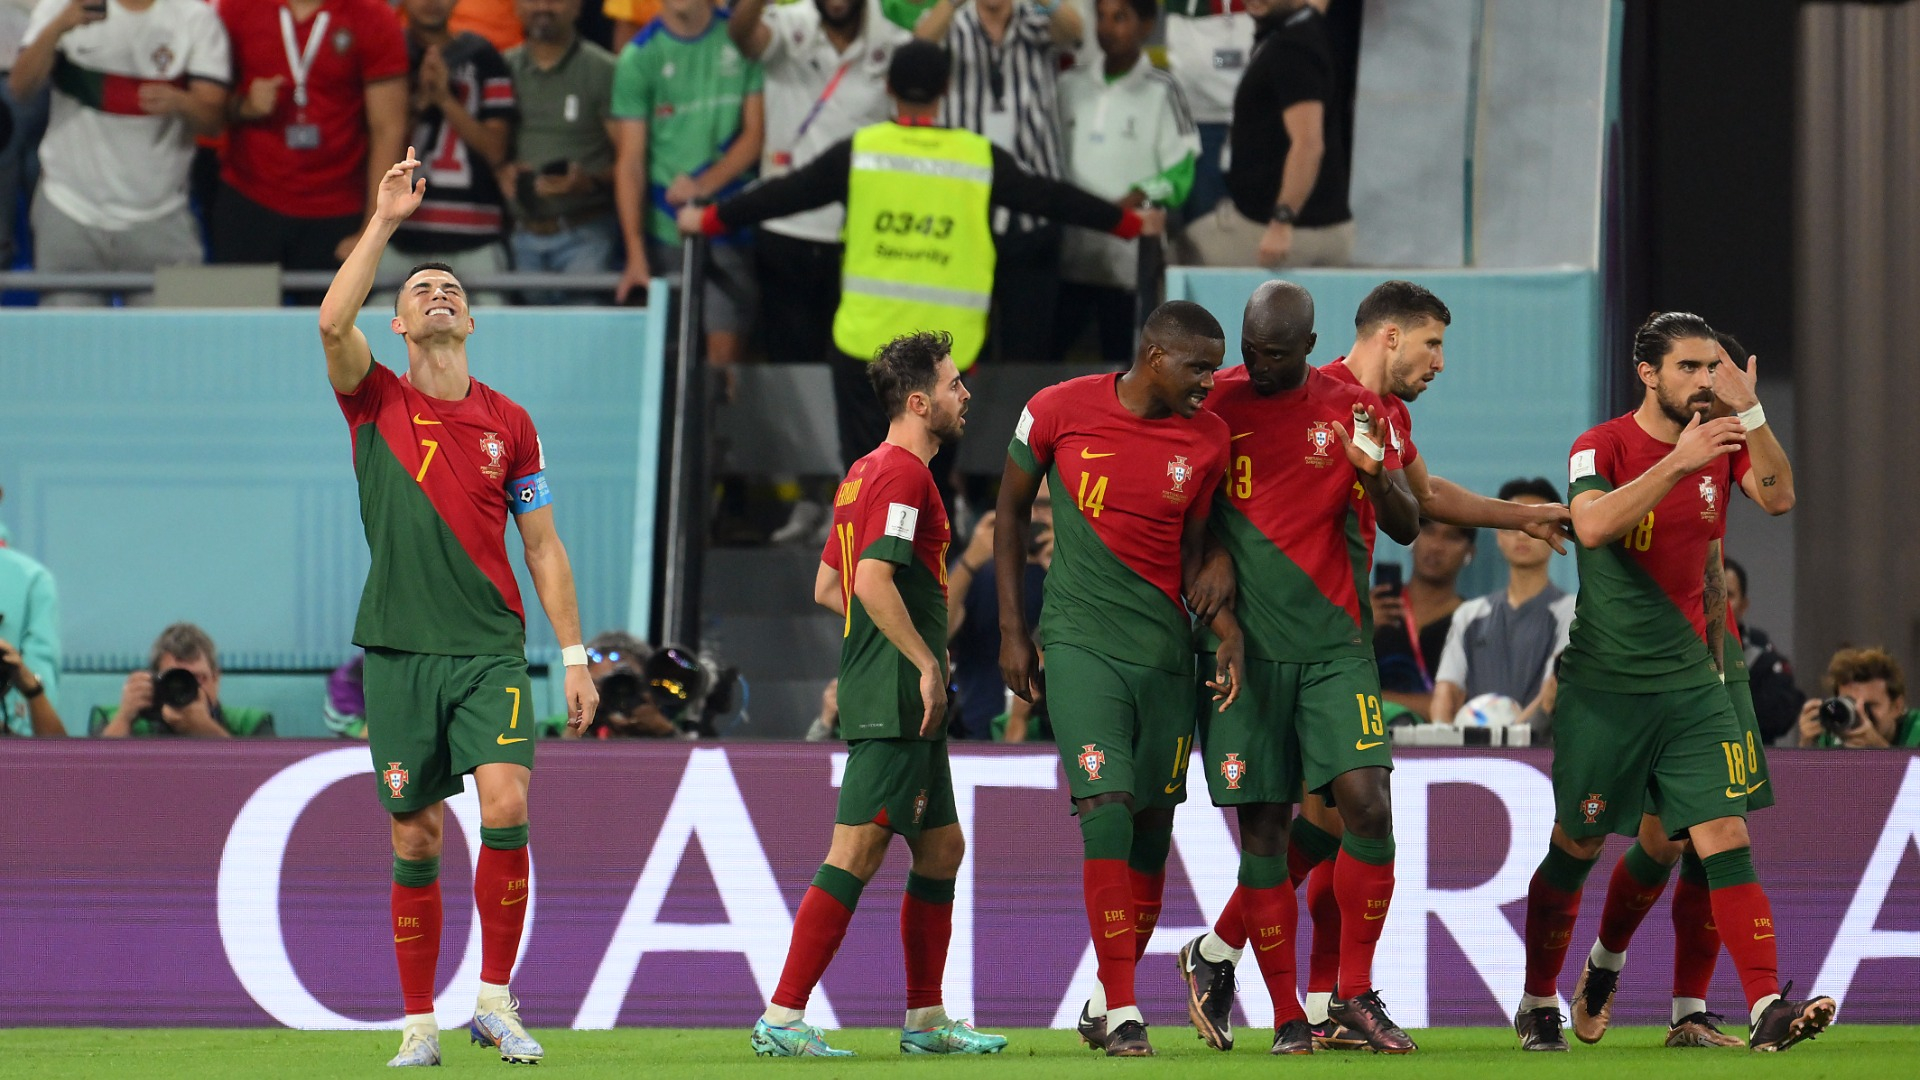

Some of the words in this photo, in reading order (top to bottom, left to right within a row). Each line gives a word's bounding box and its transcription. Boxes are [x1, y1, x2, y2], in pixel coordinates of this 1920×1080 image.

[874, 210, 955, 239] 0343
[875, 243, 951, 267] Security
[417, 440, 438, 482] 7
[1078, 472, 1109, 518] 14
[506, 686, 521, 728] 7
[1356, 693, 1384, 736] 13
[1722, 742, 1746, 785] 18
